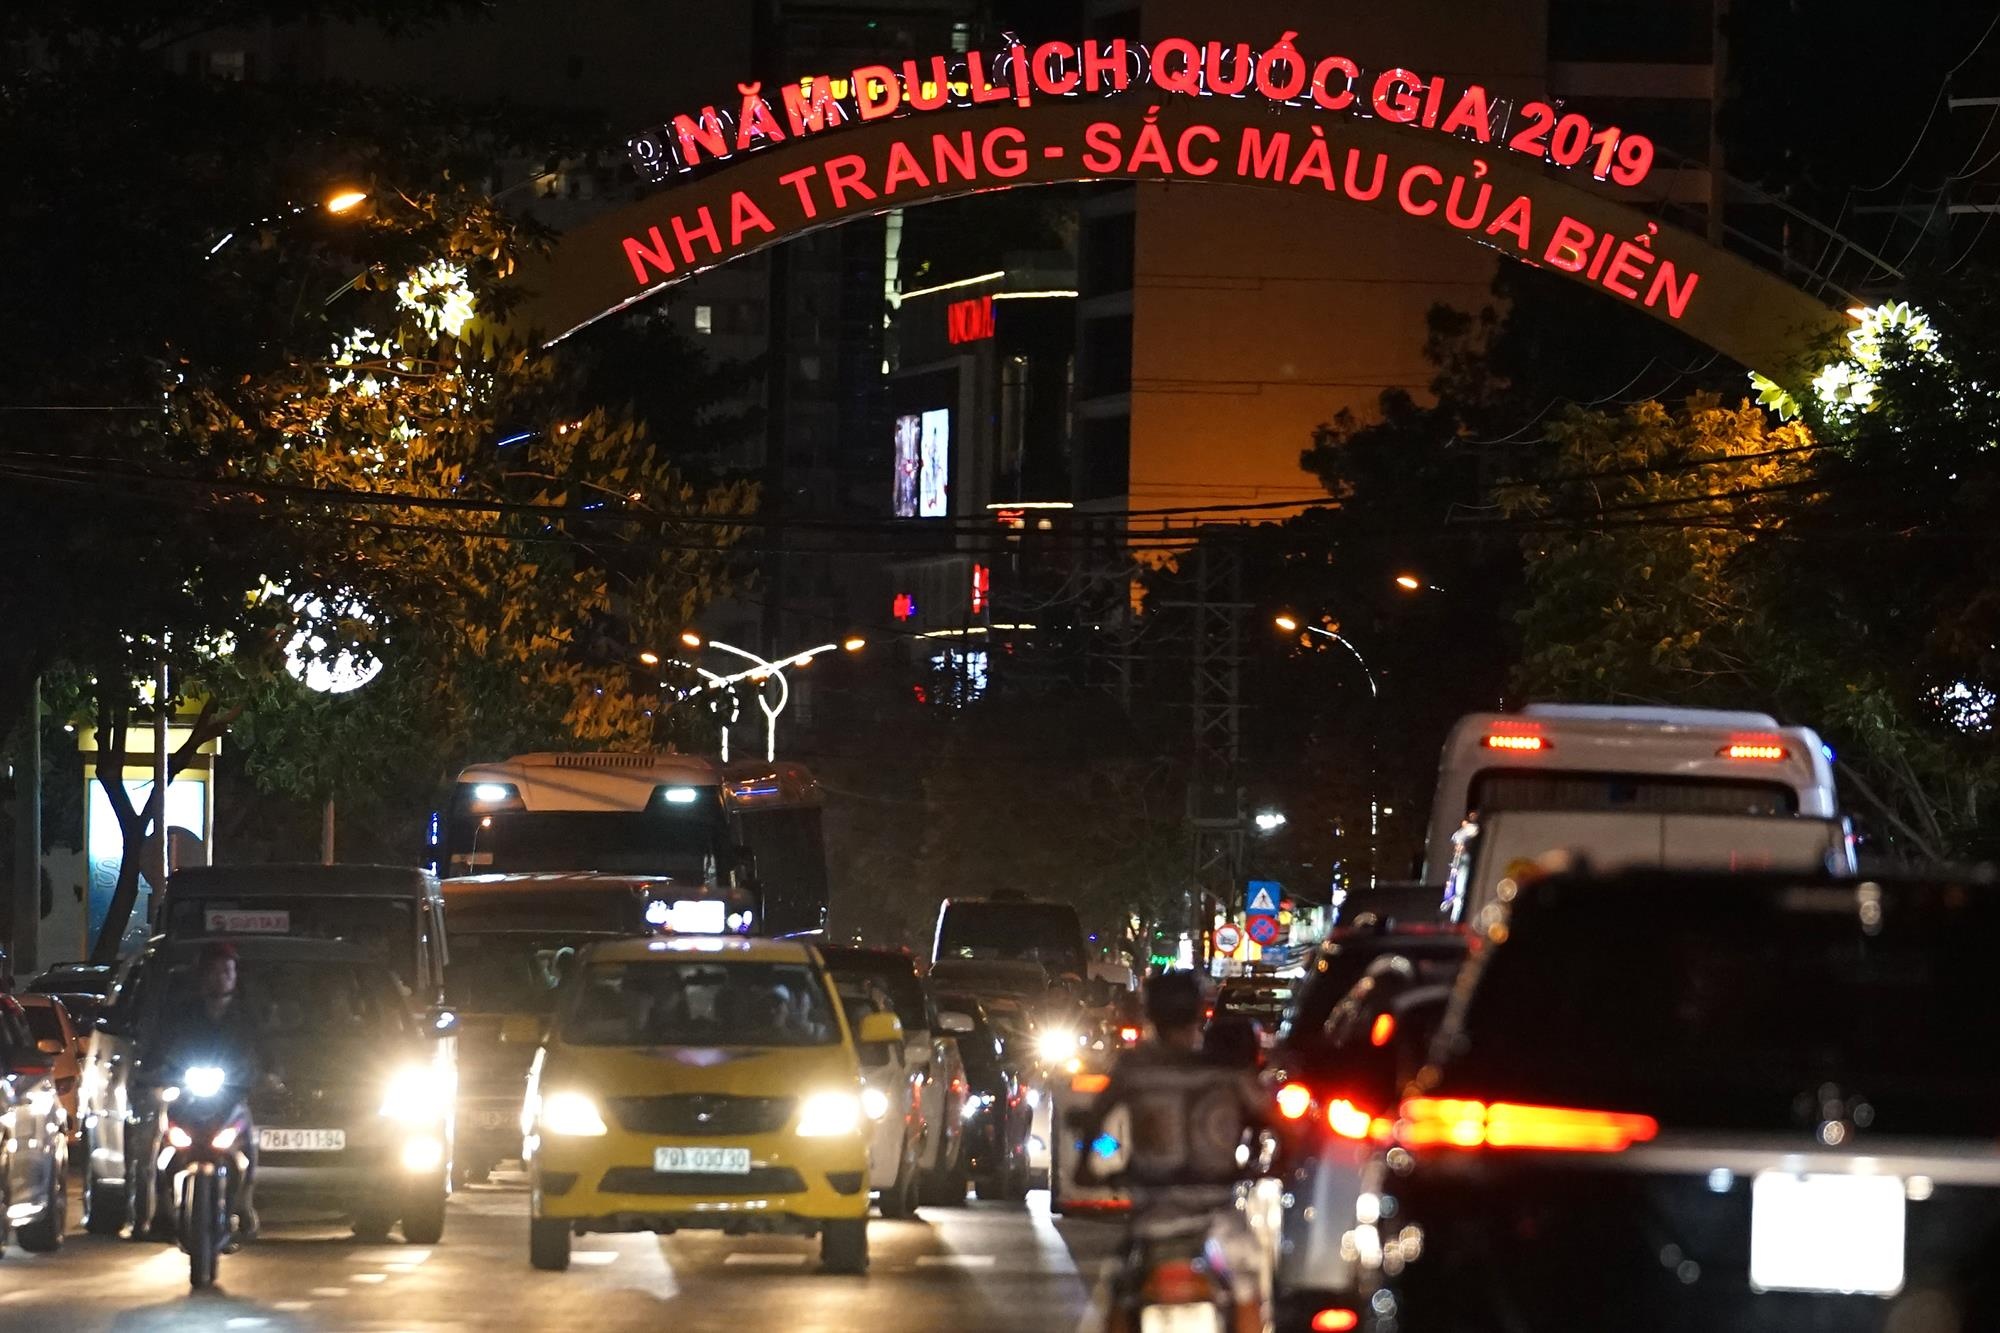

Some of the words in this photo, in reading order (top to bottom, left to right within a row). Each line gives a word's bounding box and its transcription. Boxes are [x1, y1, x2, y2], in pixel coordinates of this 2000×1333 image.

[673, 81, 841, 167] NĂM
[851, 54, 949, 121] DU
[967, 38, 1129, 108] LỊCH
[1149, 31, 1359, 110] QUỐC
[1372, 67, 1491, 143] GIA
[1509, 101, 1655, 187] 2019
[622, 190, 776, 285] NHA
[779, 126, 1028, 218] TRANG
[1082, 105, 1220, 174] SẮC
[1237, 125, 1388, 201] MÀU
[1398, 159, 1531, 250] CỦA
[1543, 222, 1699, 319] BIỂN
